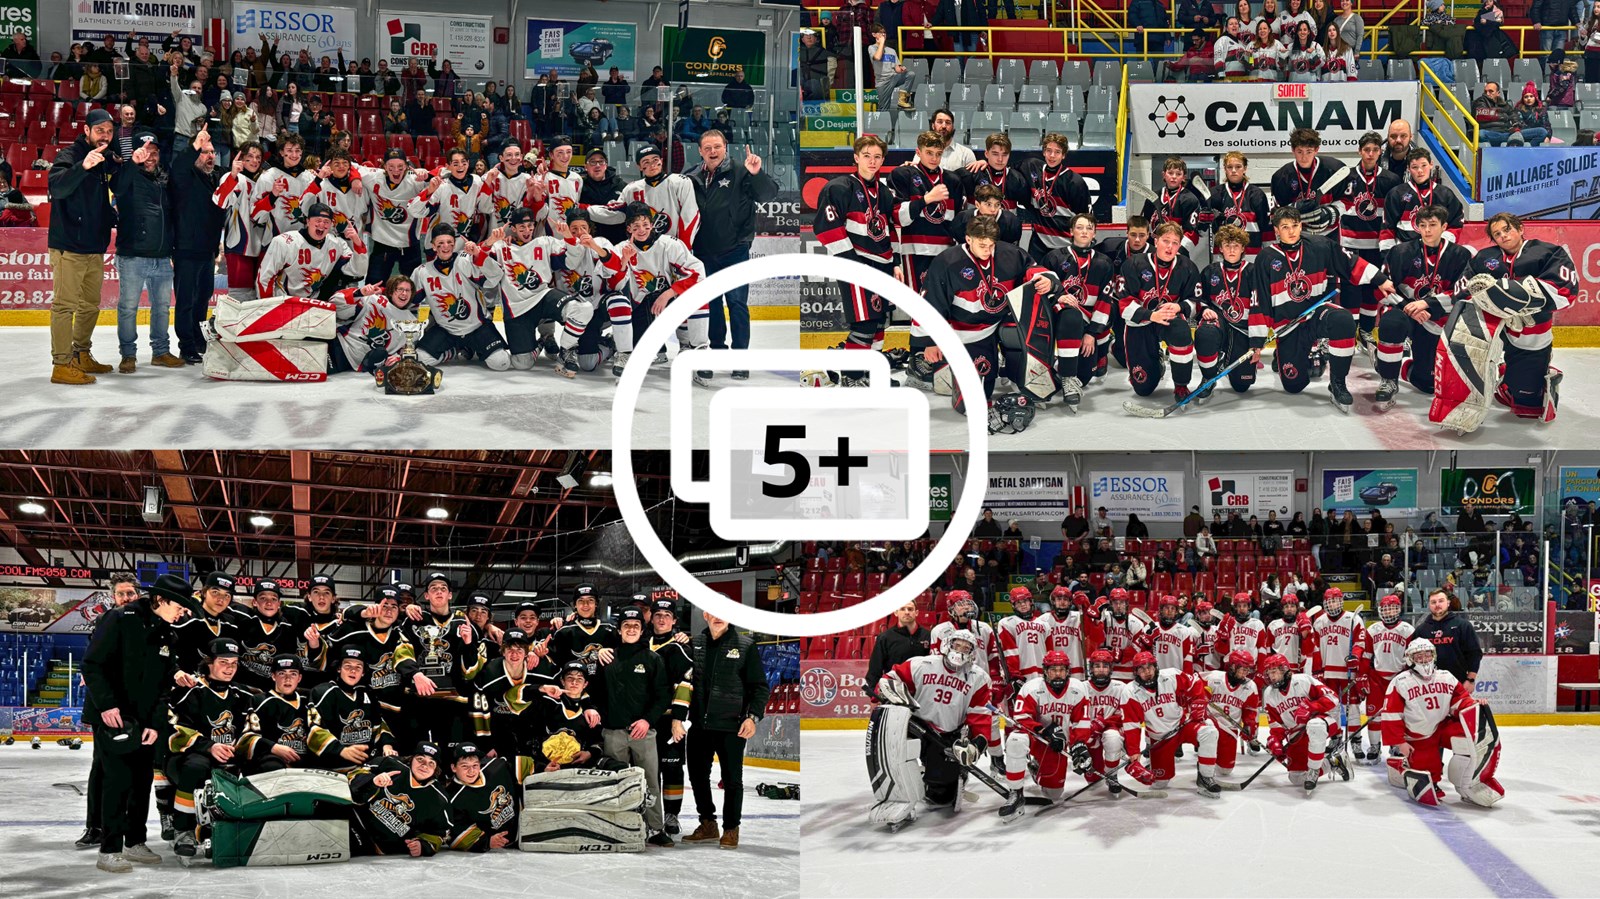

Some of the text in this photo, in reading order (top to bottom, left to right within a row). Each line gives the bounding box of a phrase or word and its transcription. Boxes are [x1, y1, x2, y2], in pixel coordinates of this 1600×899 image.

[135, 2, 195, 19] SARTIGAN
[259, 10, 335, 33] ESSOR
[685, 62, 743, 72] CONDORS
[1278, 84, 1306, 98] SORTIE
[1205, 100, 1402, 132] CANAM
[1204, 139, 1224, 147] Des
[1227, 138, 1277, 147] solutions
[1487, 152, 1598, 193] UN ALLIAGE SOLIDE
[1495, 186, 1532, 200] SAVOIR-FAIRE
[427, 276, 442, 291] 74
[299, 297, 332, 308] CCM
[801, 302, 845, 314] 8044
[1434, 355, 1444, 395] CCM
[990, 476, 1063, 489] MÉTAL SARTIGAN
[1111, 477, 1169, 493] ESSOR
[1111, 493, 1154, 501] ASSURANCES
[1228, 495, 1250, 506] CRB
[1462, 497, 1515, 505] CONDORS
[738, 548, 747, 566] J
[1468, 614, 1503, 623] Transport
[1016, 621, 1046, 636] DRAGON
[1050, 625, 1080, 637] RAGONS
[1274, 626, 1299, 637] DRAGO
[1319, 625, 1350, 638] DRAGONS
[1470, 620, 1544, 636] Express
[1027, 633, 1039, 644] 23
[1054, 636, 1069, 647] 20
[1111, 636, 1122, 648] 21
[1158, 632, 1182, 648] AGONS
[1234, 635, 1246, 645] 22
[1284, 636, 1291, 646] 7
[1327, 635, 1338, 646] 24
[1373, 632, 1406, 647] DRAGONS
[1430, 637, 1453, 645] CKEY
[1158, 643, 1169, 654] 19
[1383, 643, 1391, 653] 11
[922, 673, 972, 696] DRAGONS
[1475, 680, 1499, 693] ers
[841, 689, 856, 698] On
[934, 688, 953, 704] 39
[1408, 682, 1454, 700] DRAGONS
[363, 692, 371, 704] A
[1143, 692, 1175, 712] DRAGONS
[1424, 696, 1440, 710] 31
[1038, 703, 1073, 716] DRAGON
[1223, 705, 1230, 716] 6
[1277, 696, 1305, 714] DRAGO
[1155, 707, 1164, 718] 8
[865, 720, 874, 756] VAUGHN
[577, 769, 612, 777] CCM
[307, 852, 342, 861] CCM
